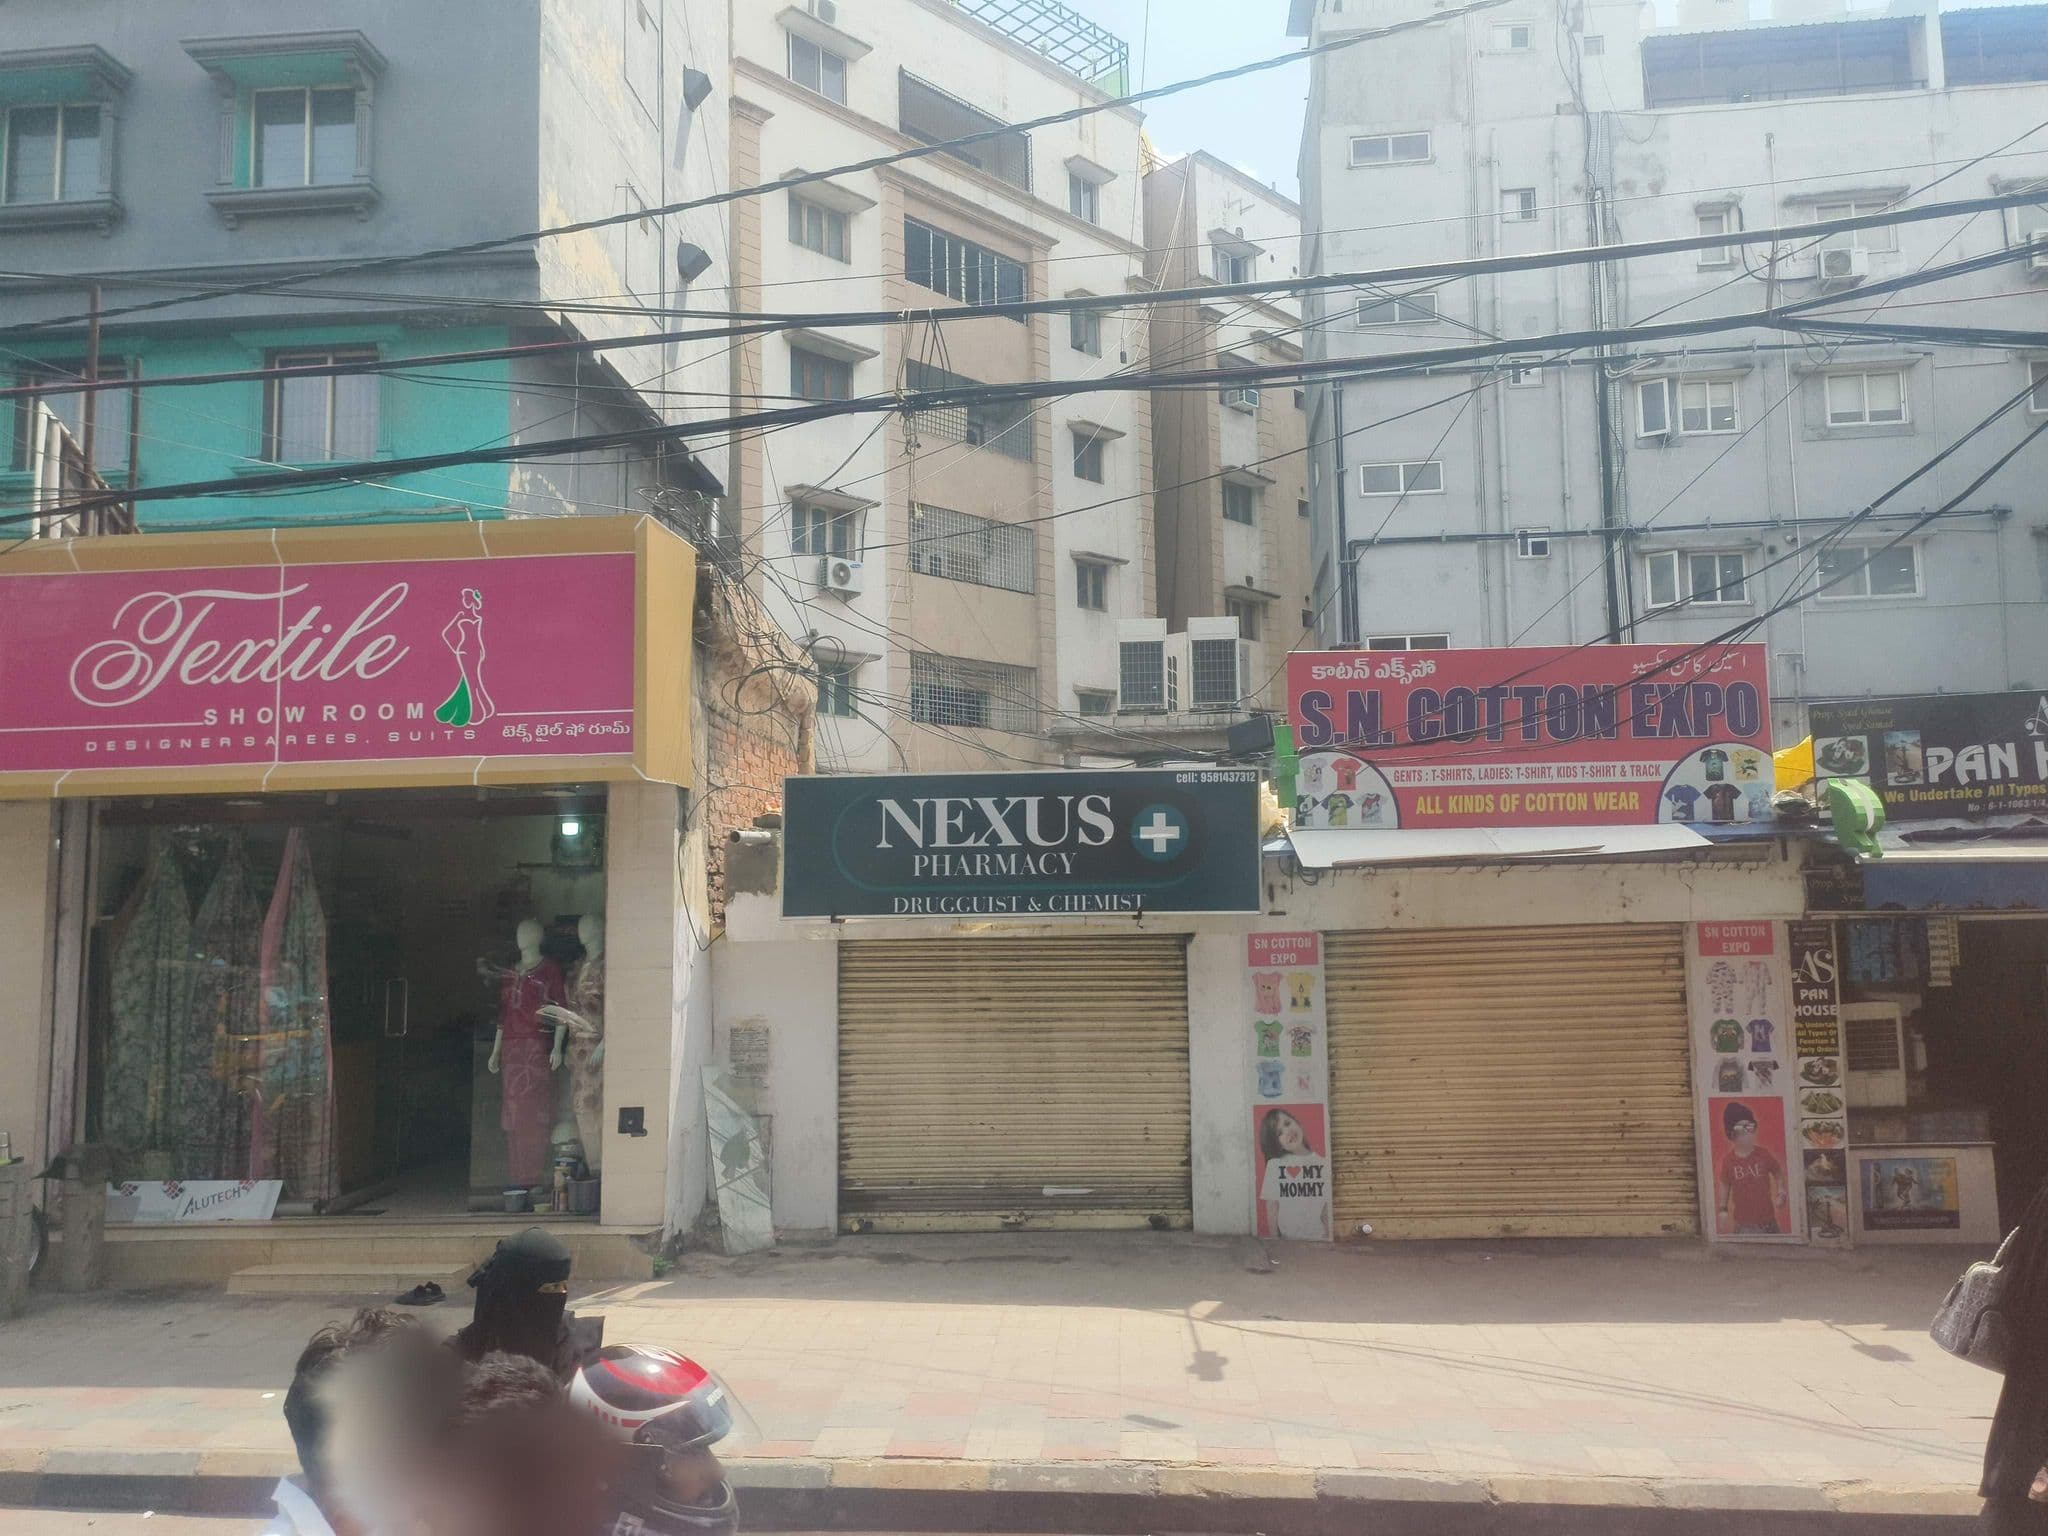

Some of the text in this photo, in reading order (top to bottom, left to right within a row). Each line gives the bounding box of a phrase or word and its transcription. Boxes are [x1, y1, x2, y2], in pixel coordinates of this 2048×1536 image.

[70, 582, 410, 707] Textile
[322, 703, 424, 723] ROOM
[1299, 681, 1760, 746] S.N. COTTON EXPO
[388, 730, 476, 743] SUITS
[1394, 769, 1423, 783] GENTS
[1478, 766, 1513, 781] LADIES:
[1556, 765, 1578, 779] KIDS
[1580, 765, 1617, 778] T-SHIRT
[1620, 764, 1627, 777] &
[1630, 763, 1661, 777] TRACK
[1925, 742, 2019, 786] PAN
[1415, 790, 1639, 815] ALL KINDS OF COTTON WEAR
[1884, 790, 1905, 804] We
[1909, 786, 1983, 802] Undertake
[1988, 784, 2004, 798] All
[876, 794, 1115, 848] NEXUS
[912, 852, 1077, 877] PHARMACY
[1027, 897, 1042, 913] &
[1049, 893, 1146, 912] CHEMIST
[1704, 925, 1766, 939] SN COTTON
[1255, 936, 1312, 950] SN COTTON
[1722, 941, 1751, 953] EXPO
[1270, 952, 1297, 964] EXPO
[1800, 988, 1829, 1001] PAN
[1794, 1004, 1838, 1017] HOUSE
[1278, 1164, 1324, 1179] I MY
[1280, 1181, 1325, 1198] MOMMY
[182, 1186, 241, 1218] ALUTECH
